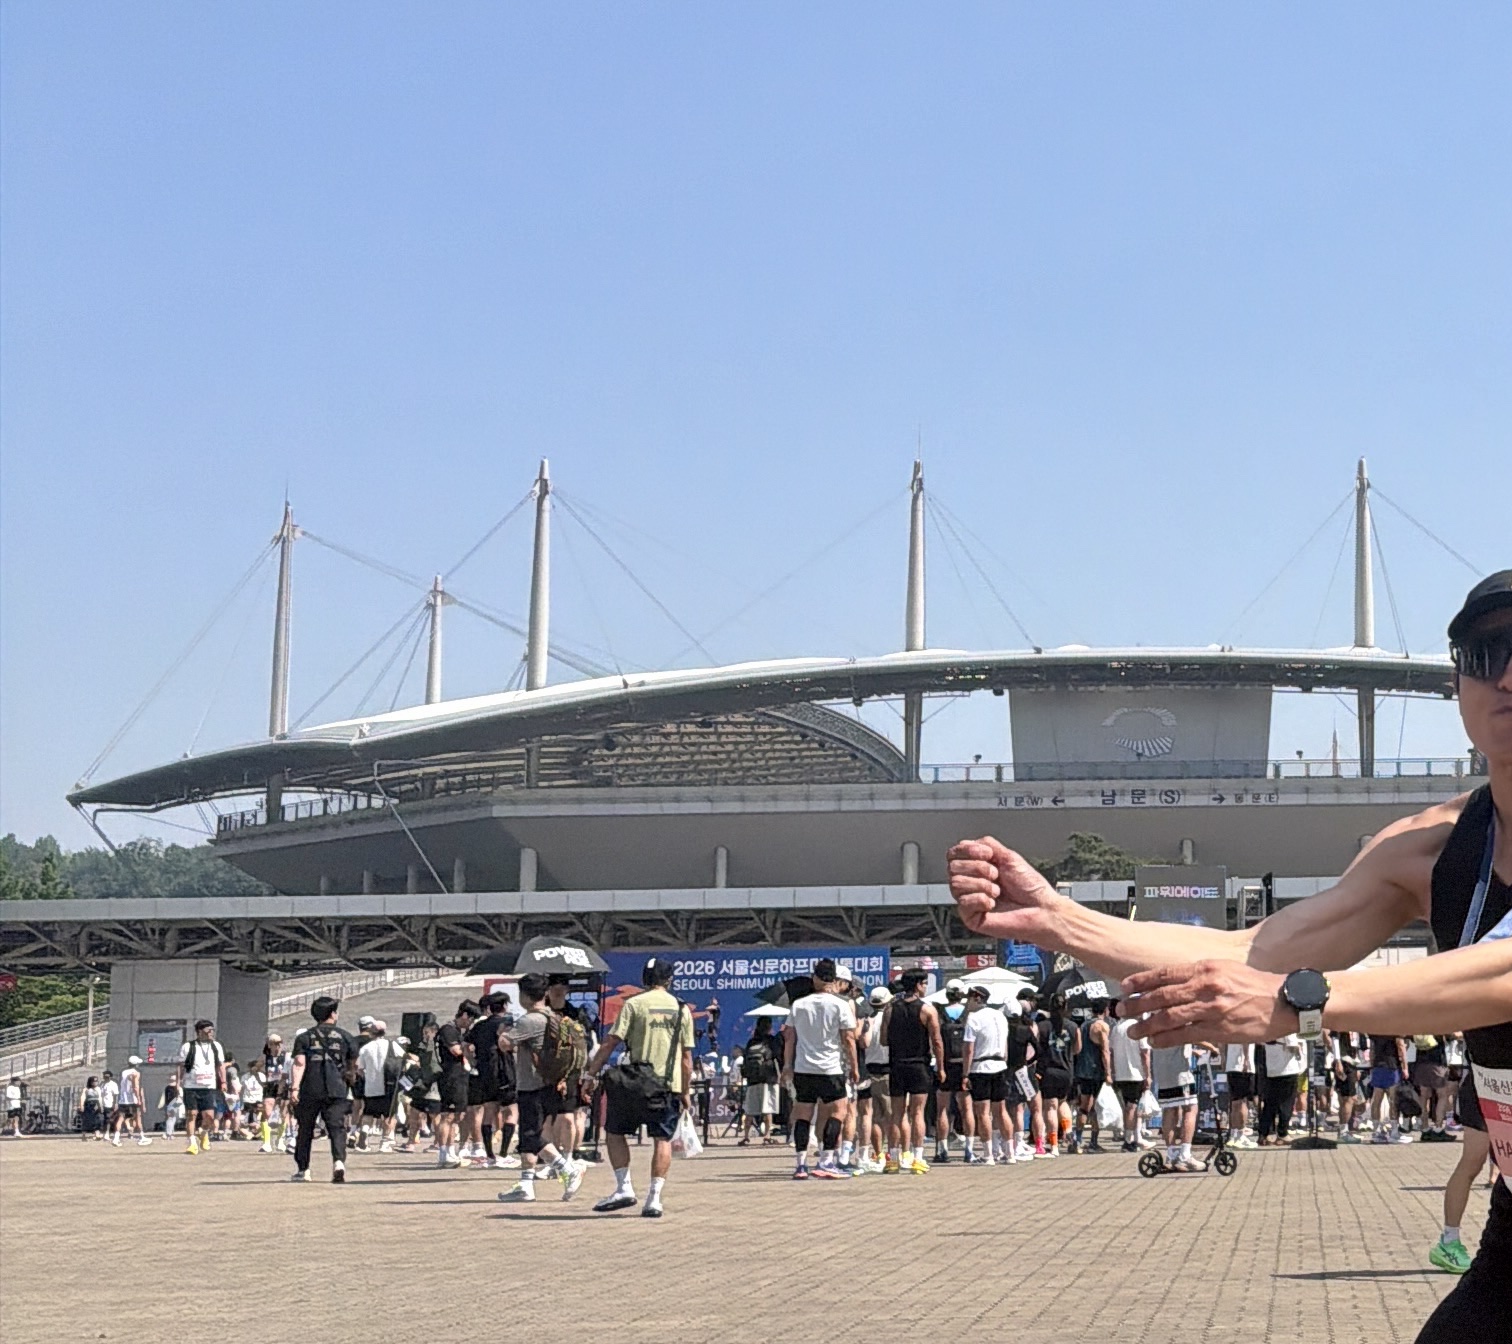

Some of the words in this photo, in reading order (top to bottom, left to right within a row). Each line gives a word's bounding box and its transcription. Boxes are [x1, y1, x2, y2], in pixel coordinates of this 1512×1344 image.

[1143, 885, 1221, 899] 파워에이드
[673, 960, 715, 975] 2026
[719, 956, 884, 976] 서울신문하프톤대회
[672, 978, 713, 991] SEOUL
[716, 976, 775, 990] SHINMUN
